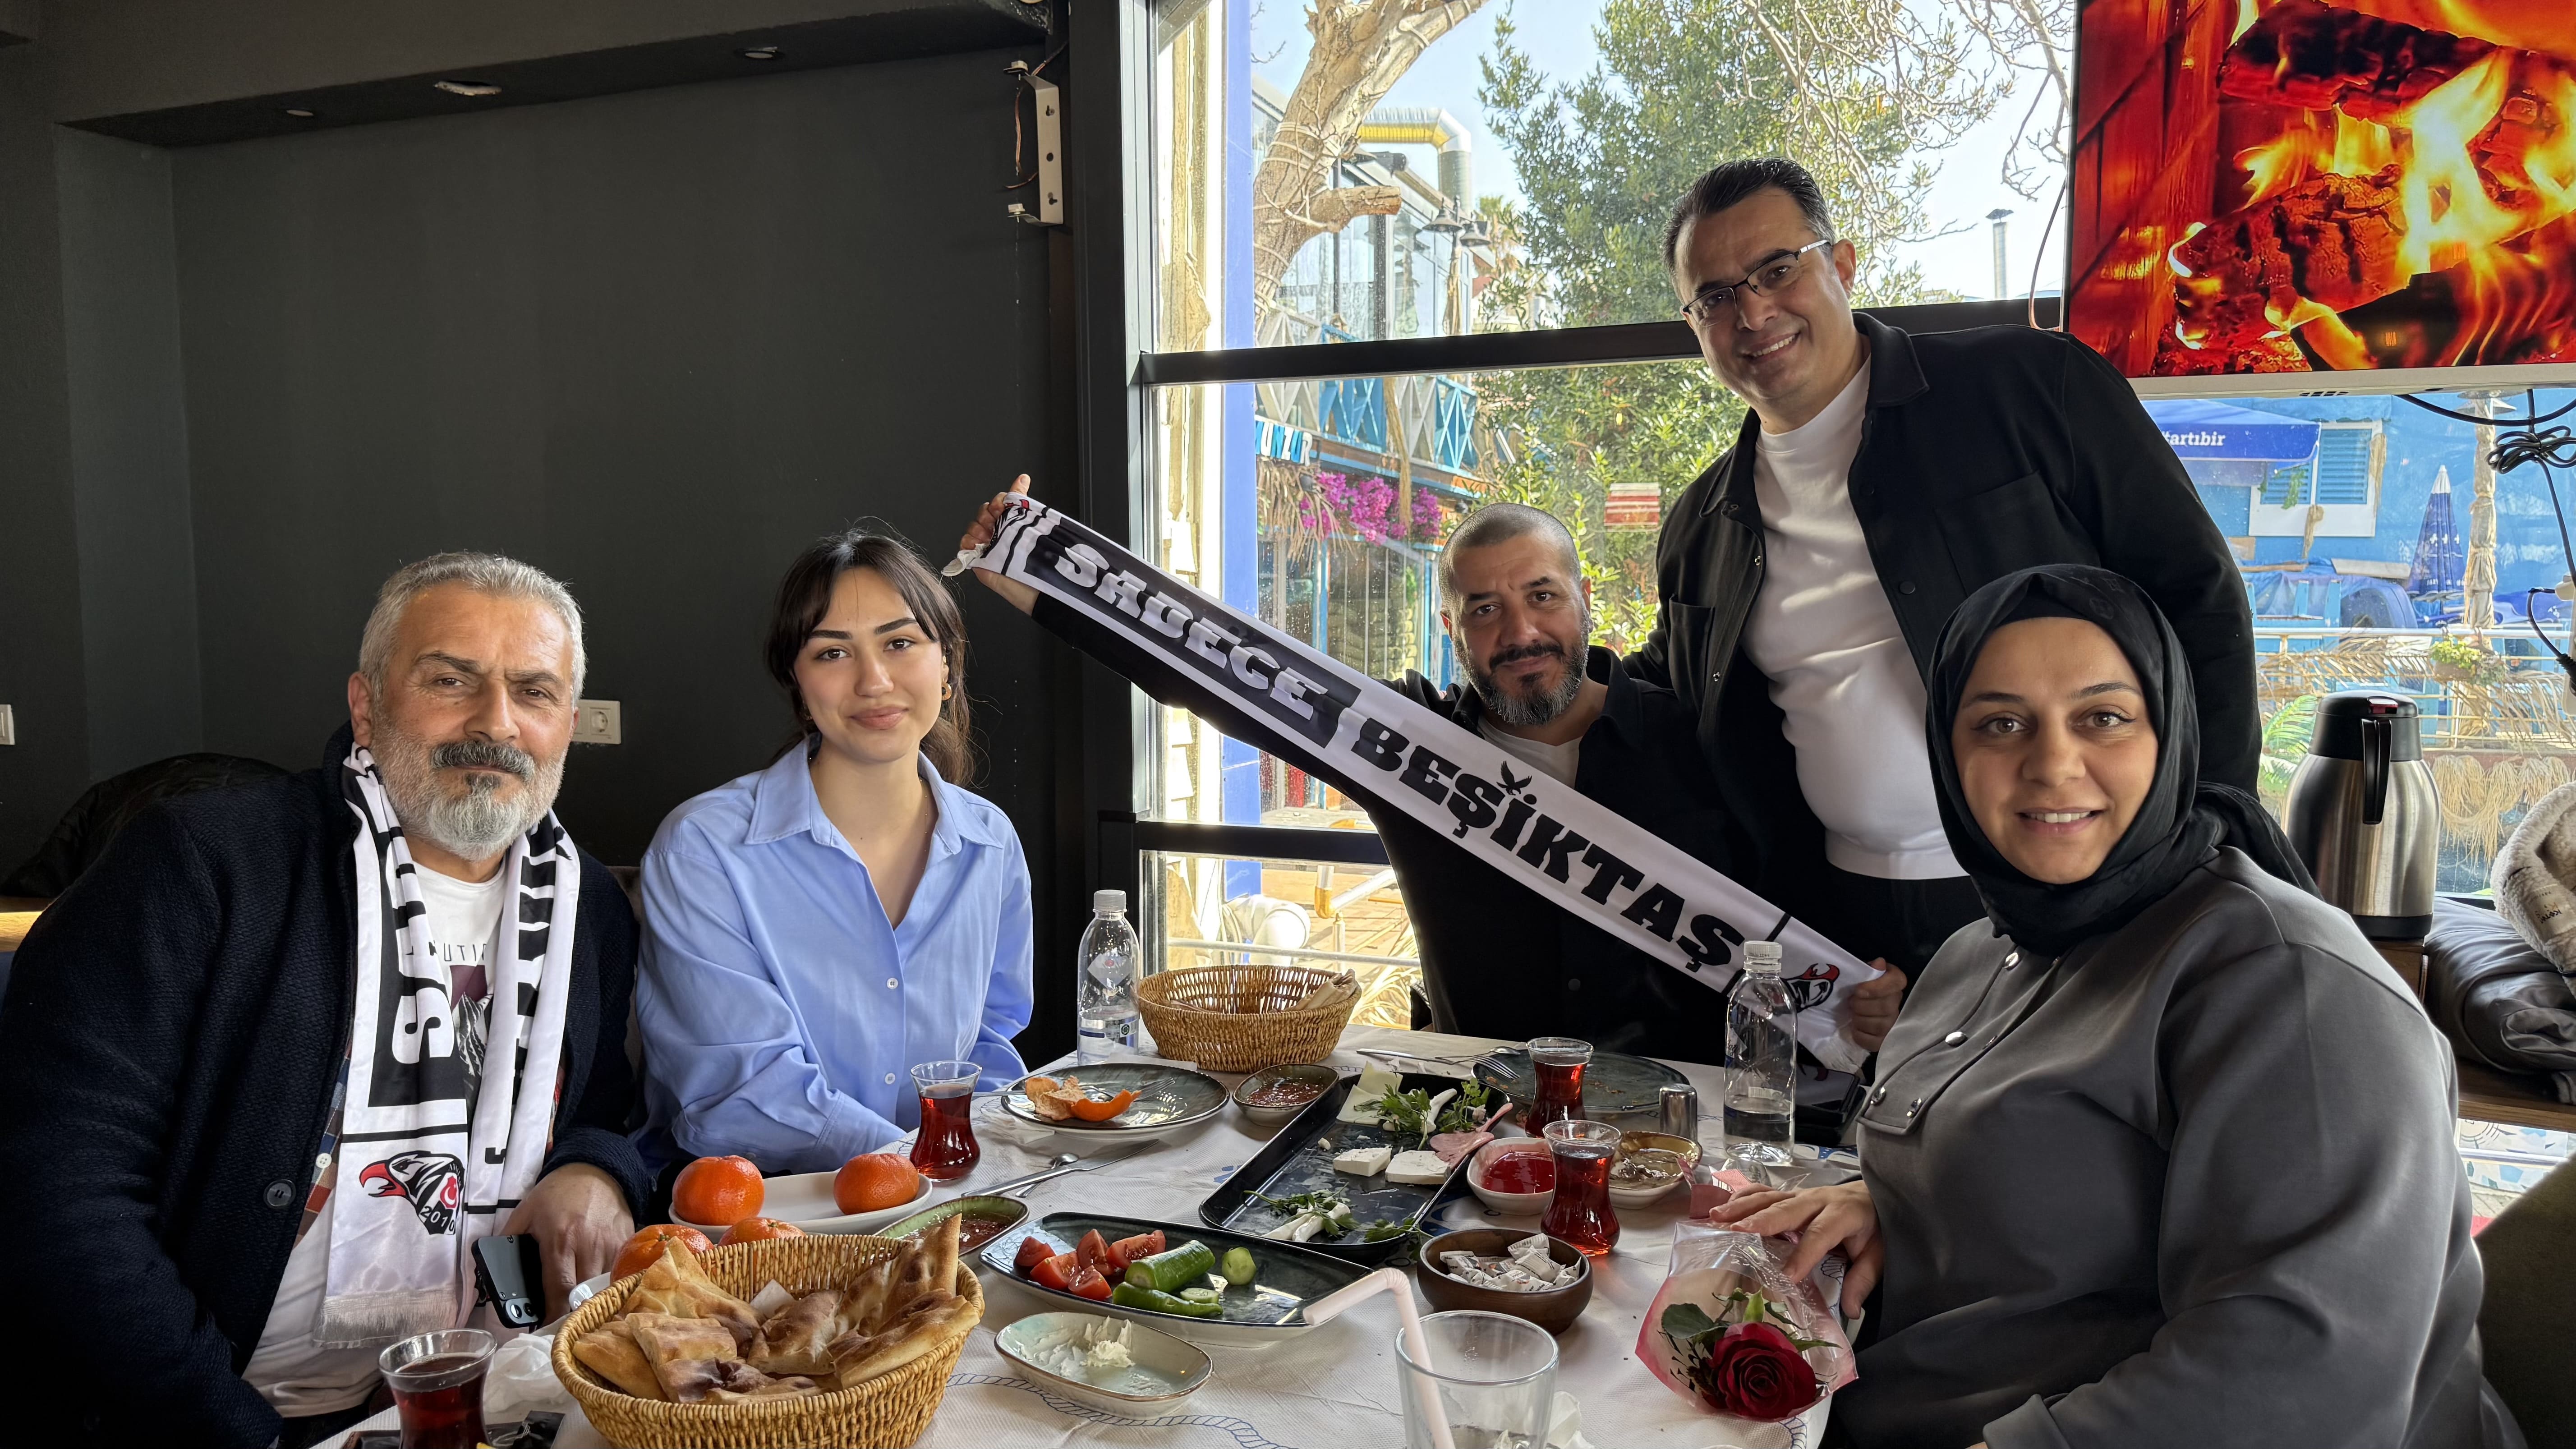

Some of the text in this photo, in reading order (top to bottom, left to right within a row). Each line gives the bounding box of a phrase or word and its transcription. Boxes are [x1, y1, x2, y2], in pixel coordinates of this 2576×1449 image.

[1054, 544, 1745, 973] SADECE BEŞİKTAŞ
[420, 1206, 455, 1232] 2010
